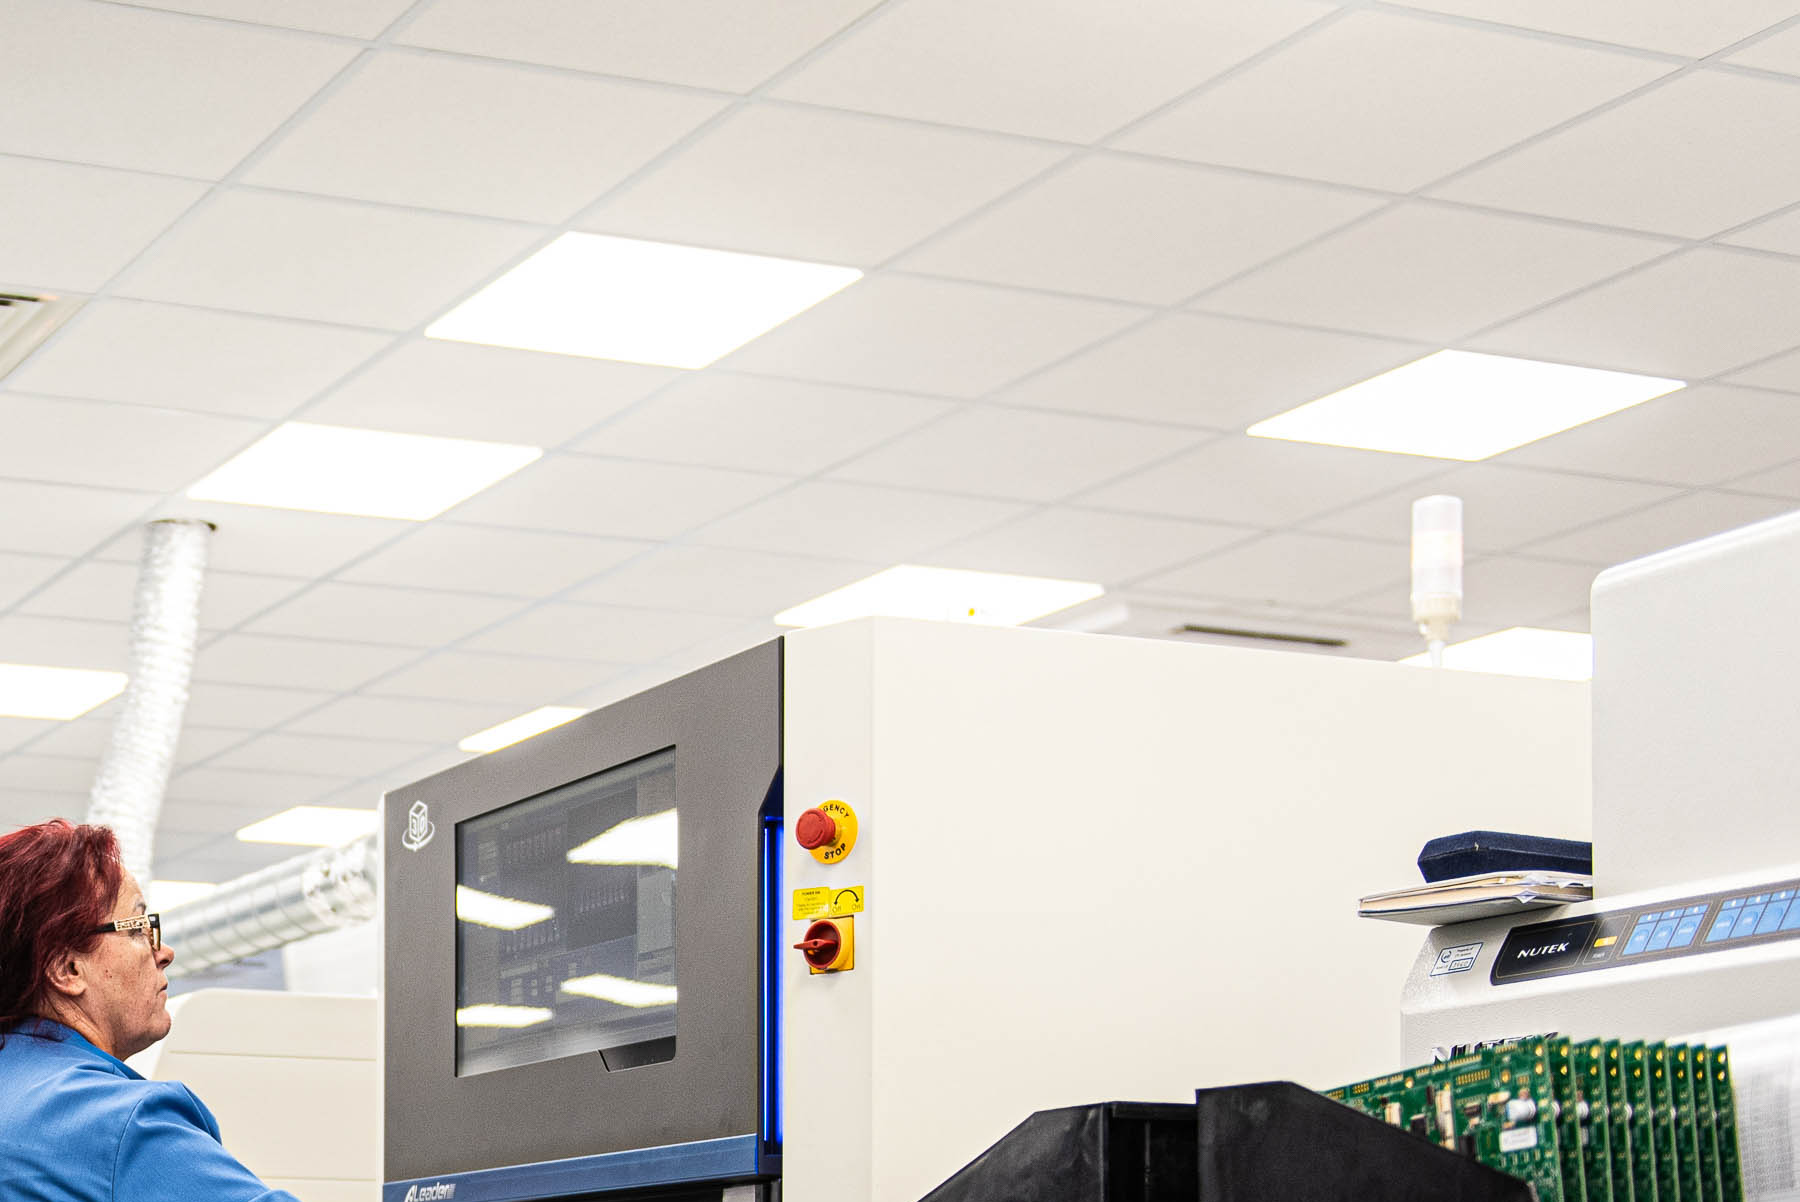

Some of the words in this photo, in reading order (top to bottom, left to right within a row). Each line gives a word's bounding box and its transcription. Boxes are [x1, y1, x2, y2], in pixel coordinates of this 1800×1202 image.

[823, 803, 850, 818] GENCY
[824, 842, 846, 860] STOP
[832, 905, 842, 914] Off
[851, 903, 861, 911] On
[1517, 942, 1570, 959] NUTEK
